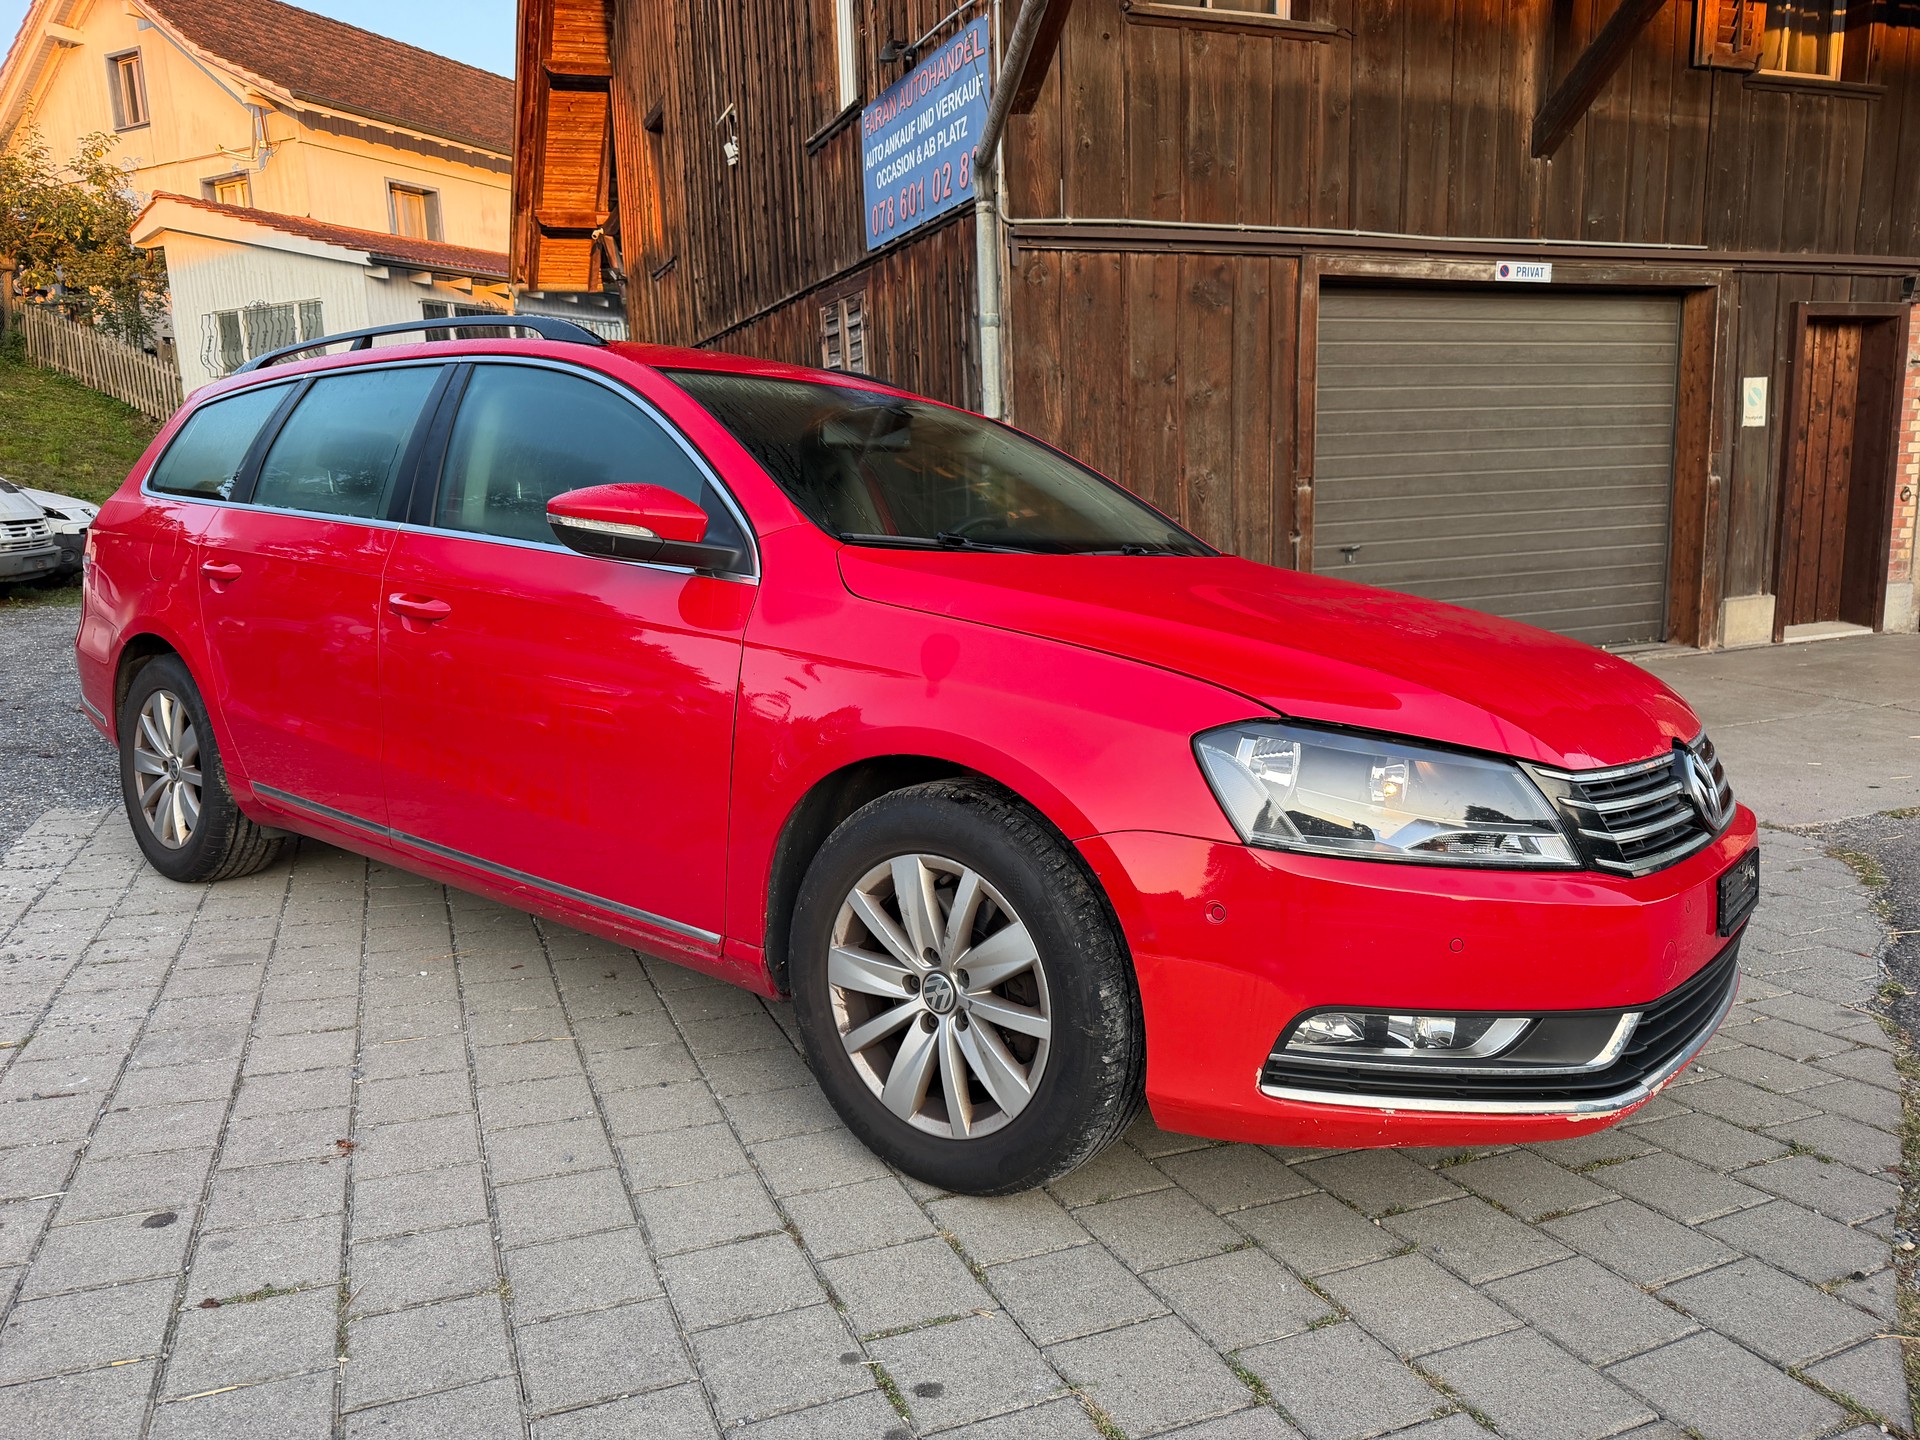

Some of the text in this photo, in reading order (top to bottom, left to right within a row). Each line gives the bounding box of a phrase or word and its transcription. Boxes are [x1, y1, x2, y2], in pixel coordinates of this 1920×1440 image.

[864, 29, 984, 138] FARAN AUTOHANDEL
[866, 73, 984, 170] AUTO ANKAUF UND VERKAUF
[876, 115, 968, 189] OCCASION & AB PLATZ
[872, 195, 895, 236] 078
[900, 176, 924, 220] 601
[932, 162, 952, 203] 02
[1516, 266, 1545, 278] PRIVAT
